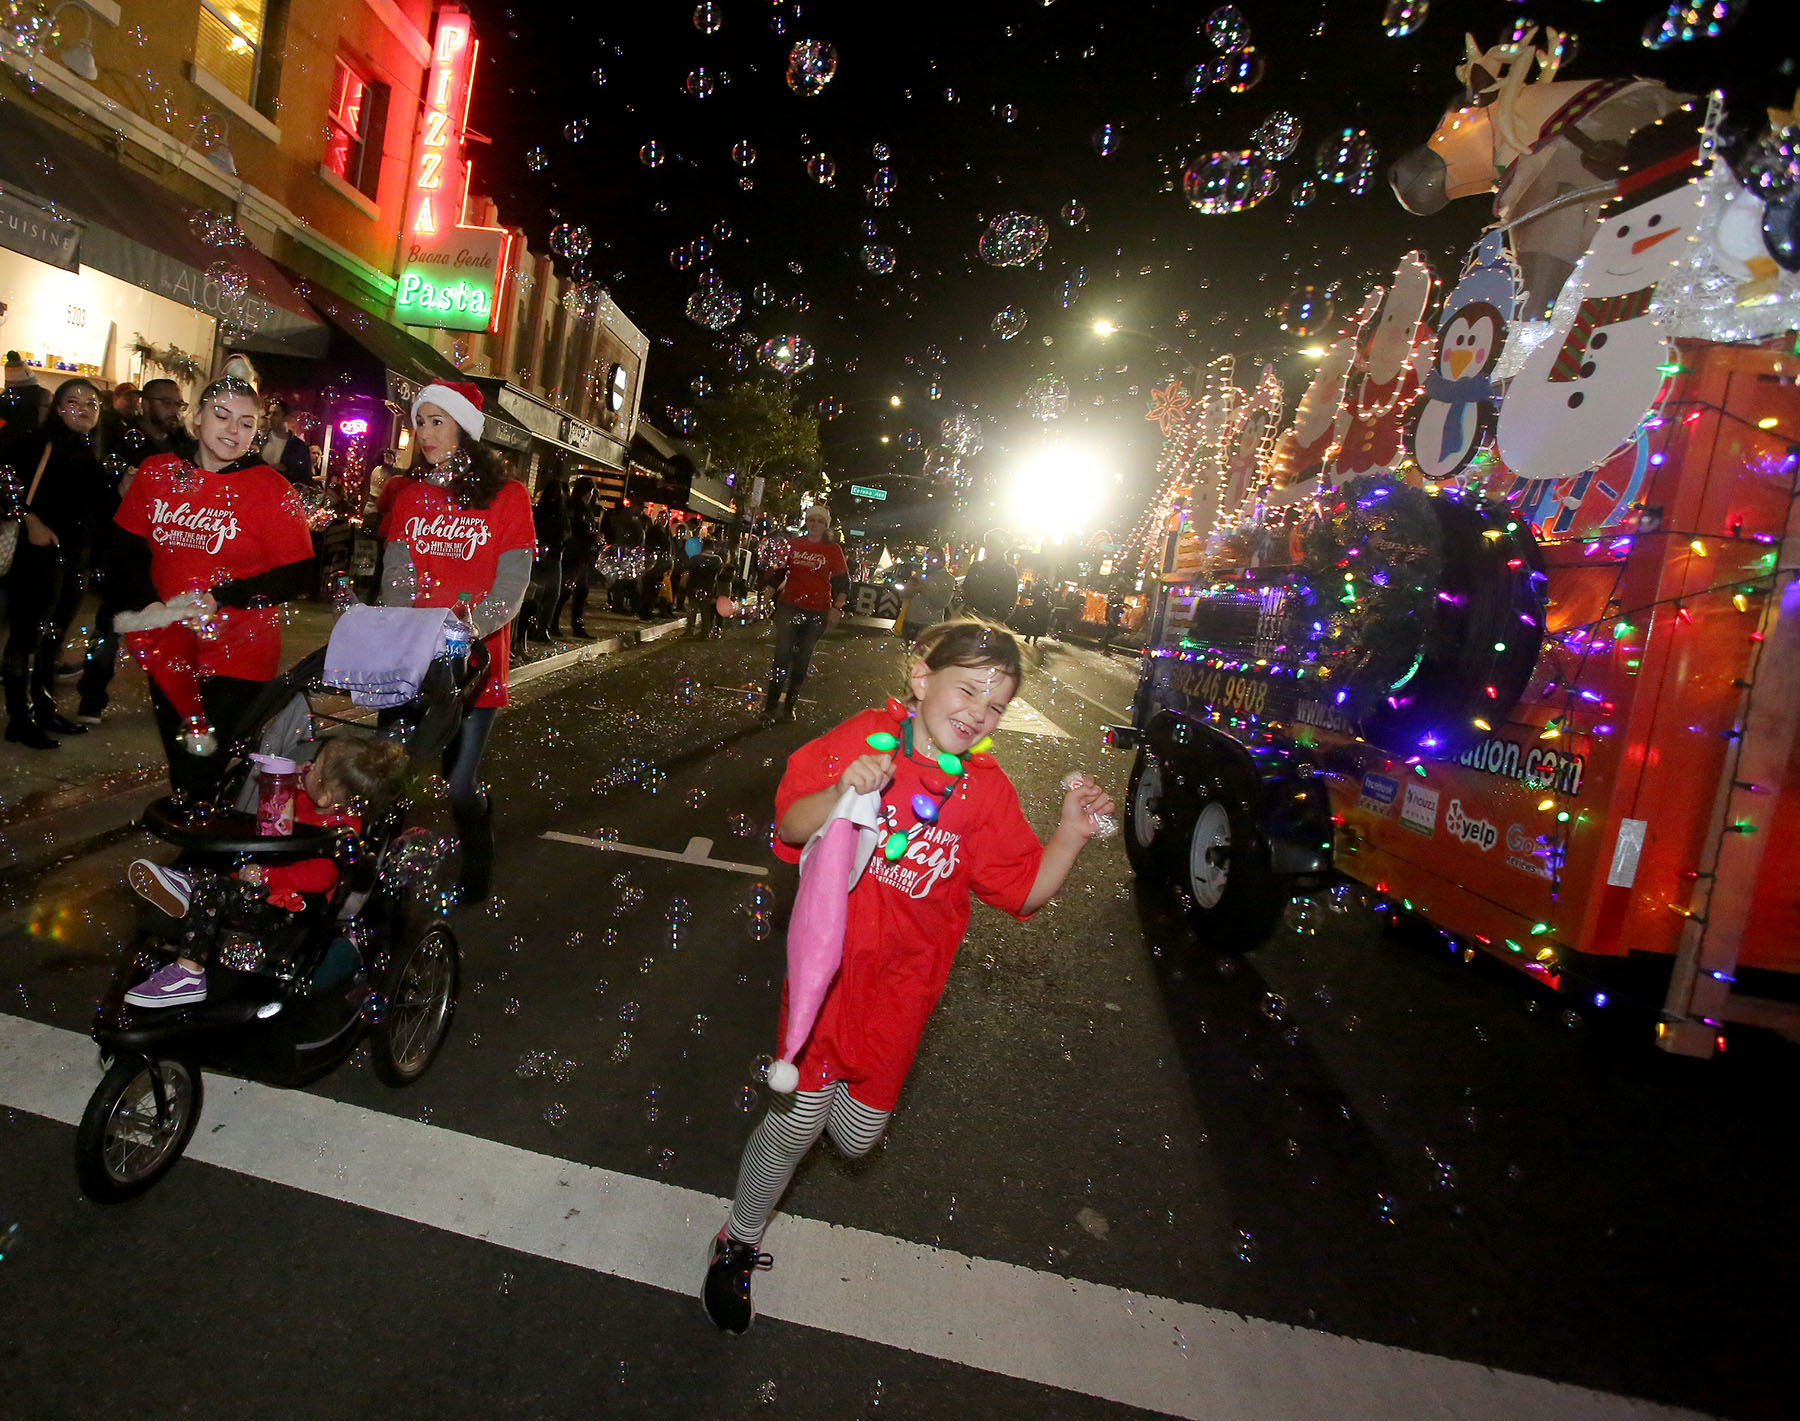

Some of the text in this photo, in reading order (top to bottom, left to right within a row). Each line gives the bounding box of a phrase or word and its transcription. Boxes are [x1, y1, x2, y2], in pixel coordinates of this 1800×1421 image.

[413, 25, 465, 233] PIZZA
[408, 244, 492, 269] Buona Gente
[398, 272, 489, 315] Pasta
[67, 304, 86, 328] 5203
[340, 419, 368, 435] OPEN
[206, 507, 235, 519] HAPPY
[460, 516, 485, 528] HAPPY
[152, 498, 242, 555] Holidays
[405, 514, 492, 561] Holidays
[923, 826, 961, 847] HAPPY
[1463, 818, 1495, 848] yelp
[870, 855, 884, 868] AVE
[900, 867, 919, 881] DAY
